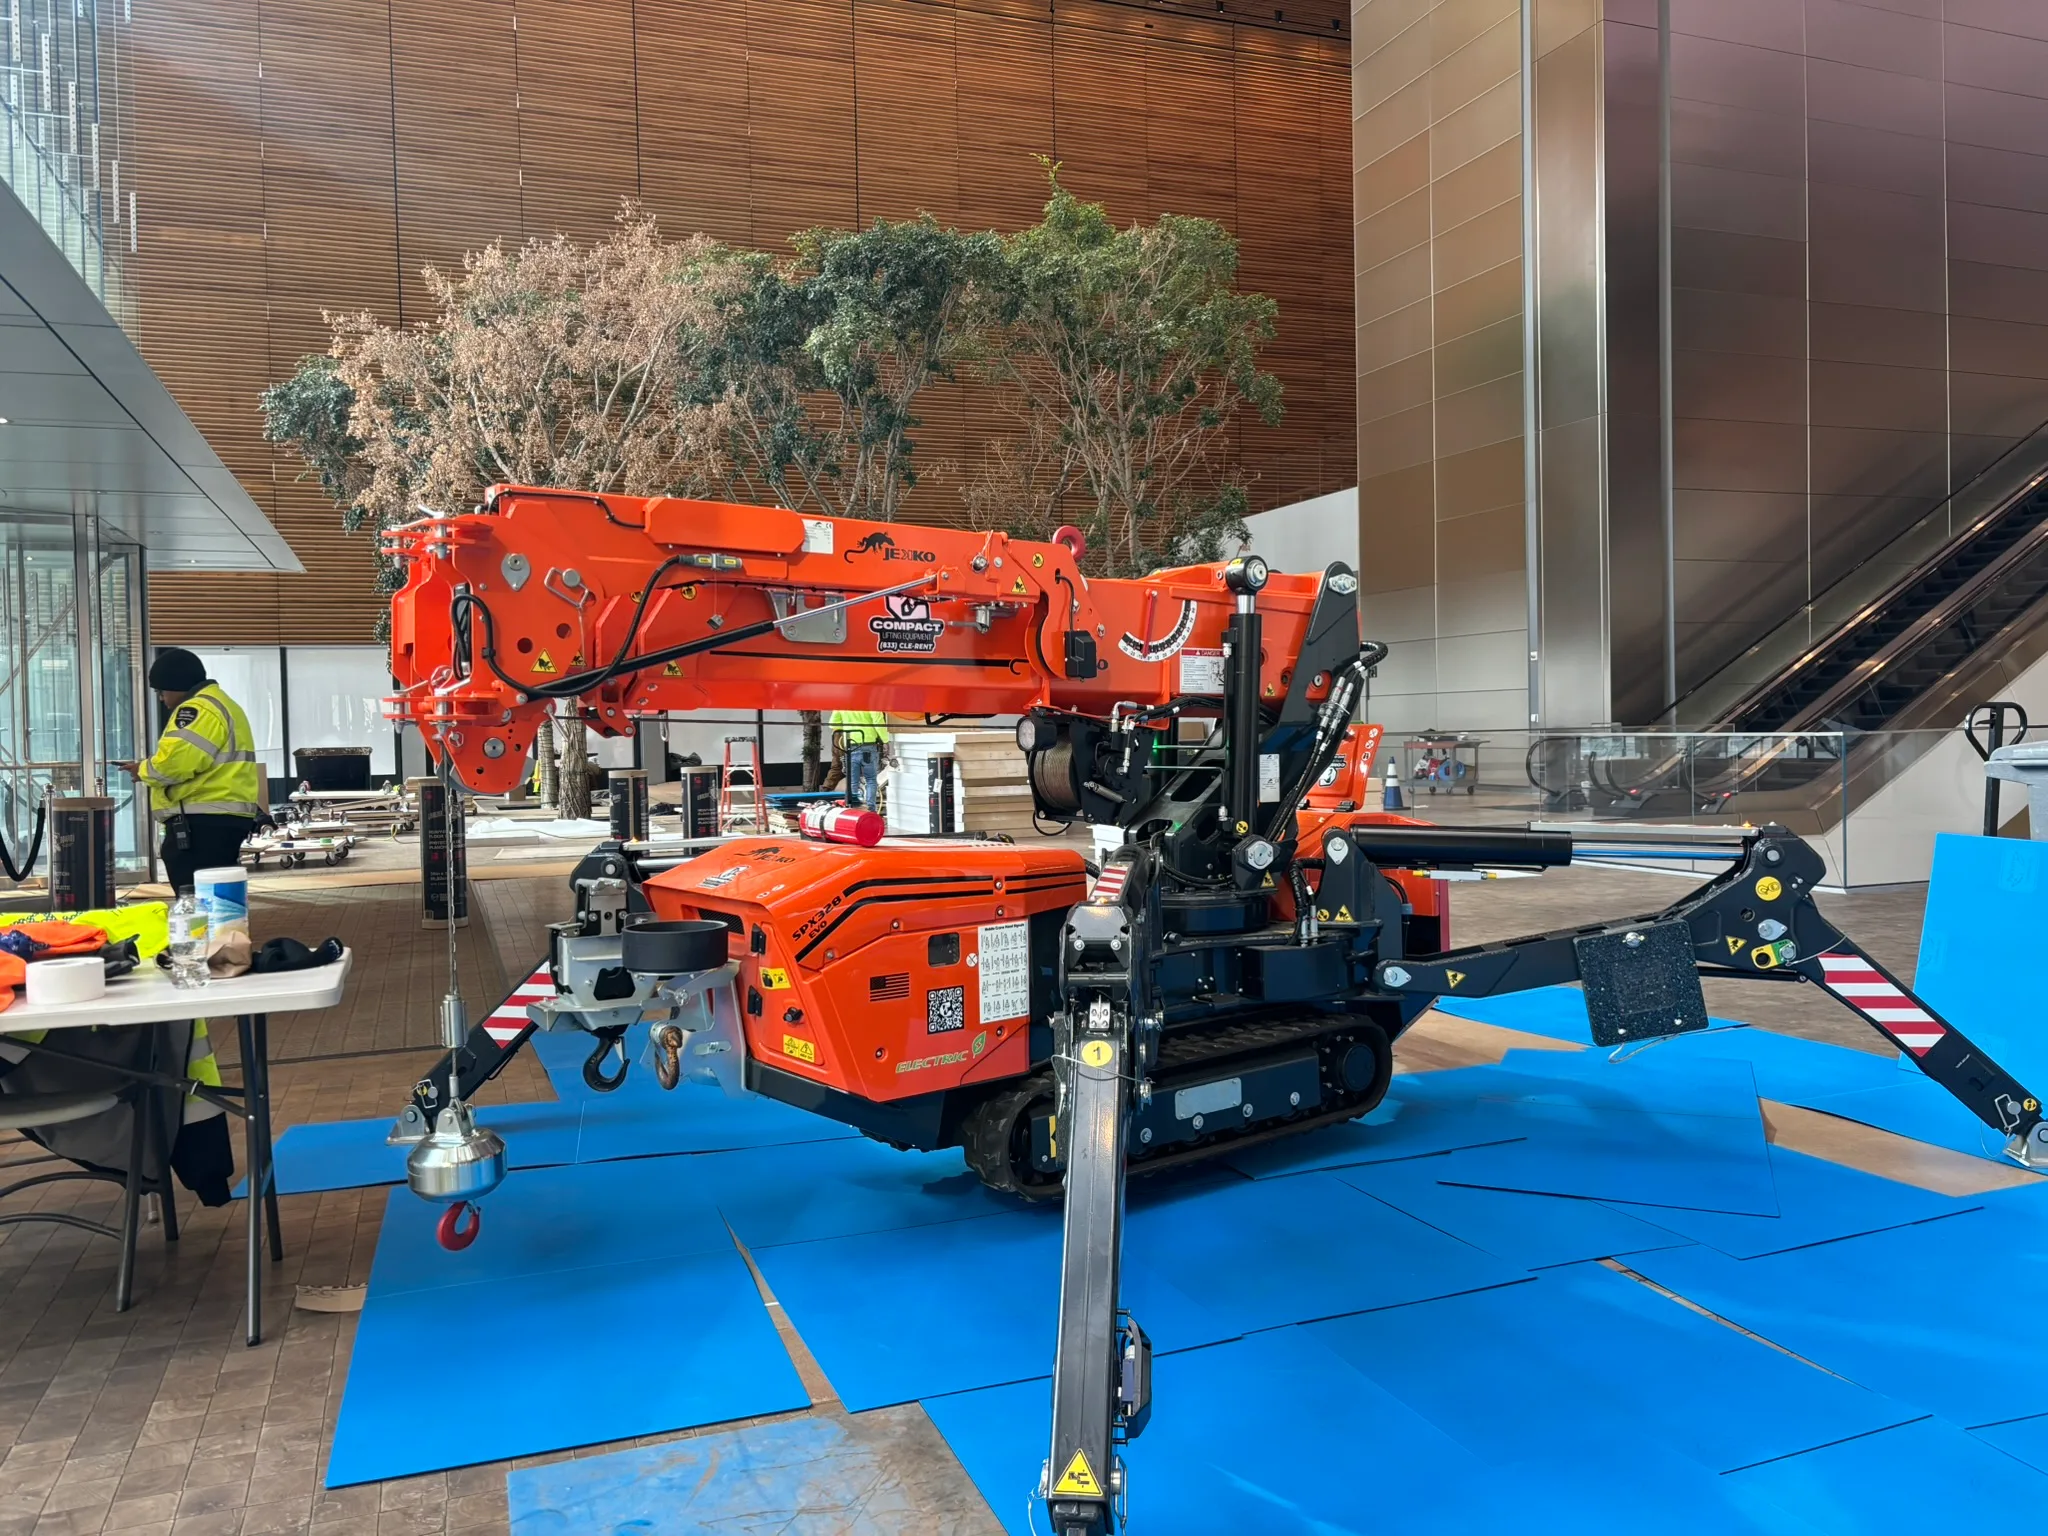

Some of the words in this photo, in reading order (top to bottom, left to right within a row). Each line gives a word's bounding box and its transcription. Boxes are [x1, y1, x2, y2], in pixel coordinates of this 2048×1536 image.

[883, 547, 936, 563] JEKKO
[872, 620, 941, 632] COMPACT
[882, 631, 901, 640] LIFTING
[903, 632, 932, 641] EQUIPMENT
[880, 641, 898, 650] (833)
[899, 642, 934, 650] CLE-RENT
[792, 895, 842, 942] SPX328
[809, 920, 828, 940] EVO
[1092, 1046, 1101, 1061] 1
[895, 1050, 969, 1074] ELECTRIC
